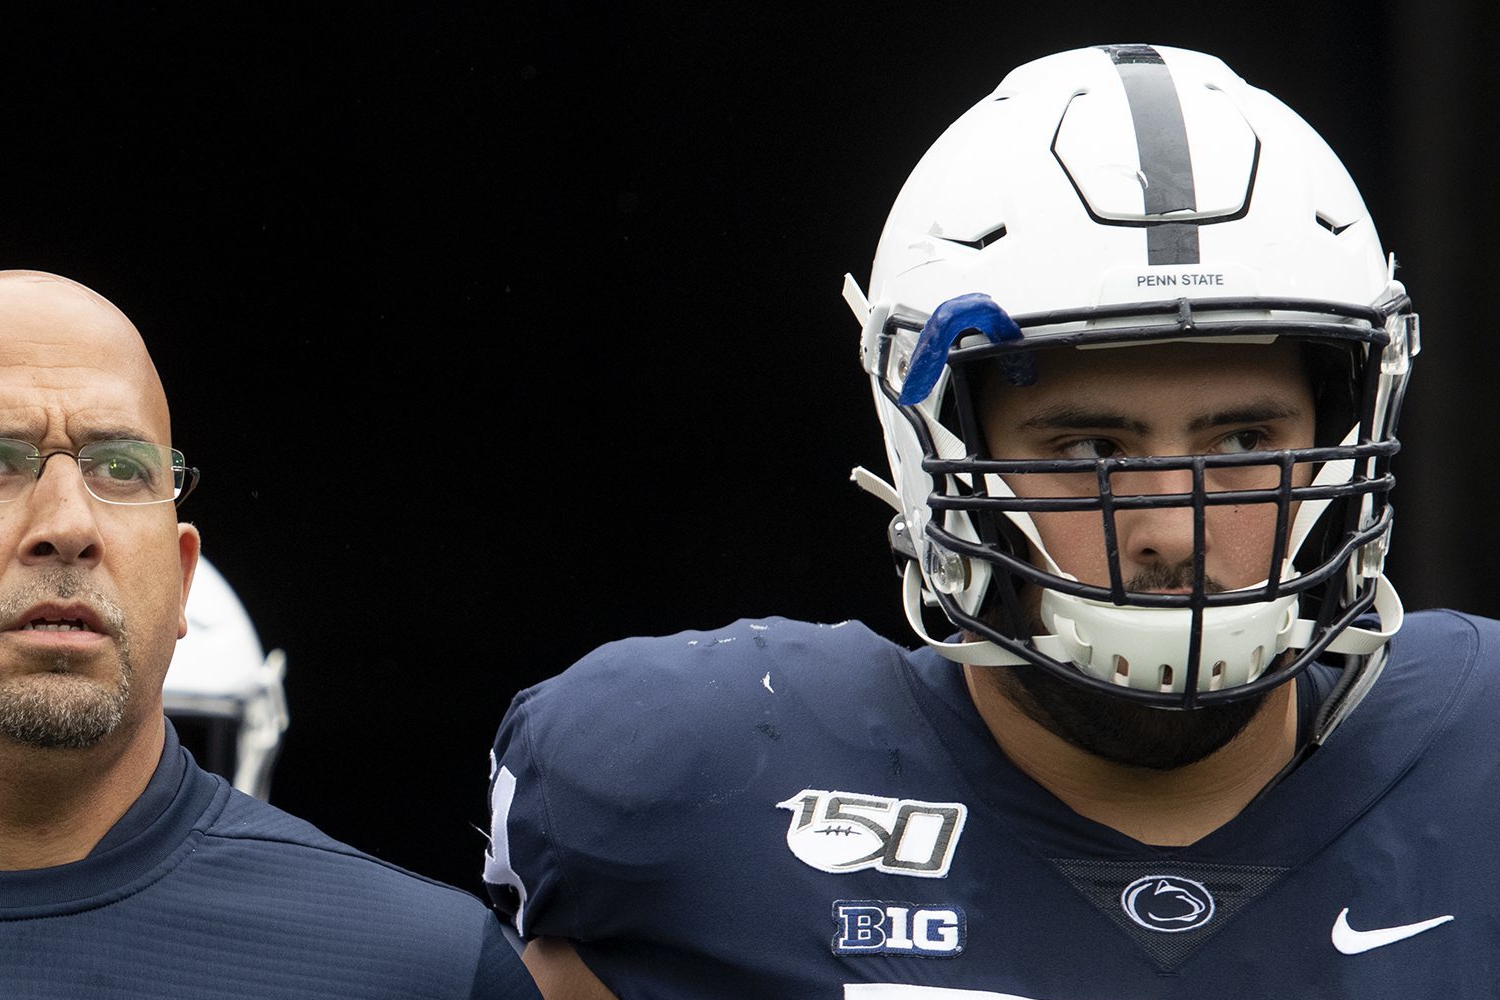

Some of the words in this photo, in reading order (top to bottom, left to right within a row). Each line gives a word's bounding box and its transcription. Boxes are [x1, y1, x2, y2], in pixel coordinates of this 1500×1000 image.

[1137, 274, 1177, 287] PENN
[1181, 273, 1224, 286] STATE
[784, 792, 963, 875] 150
